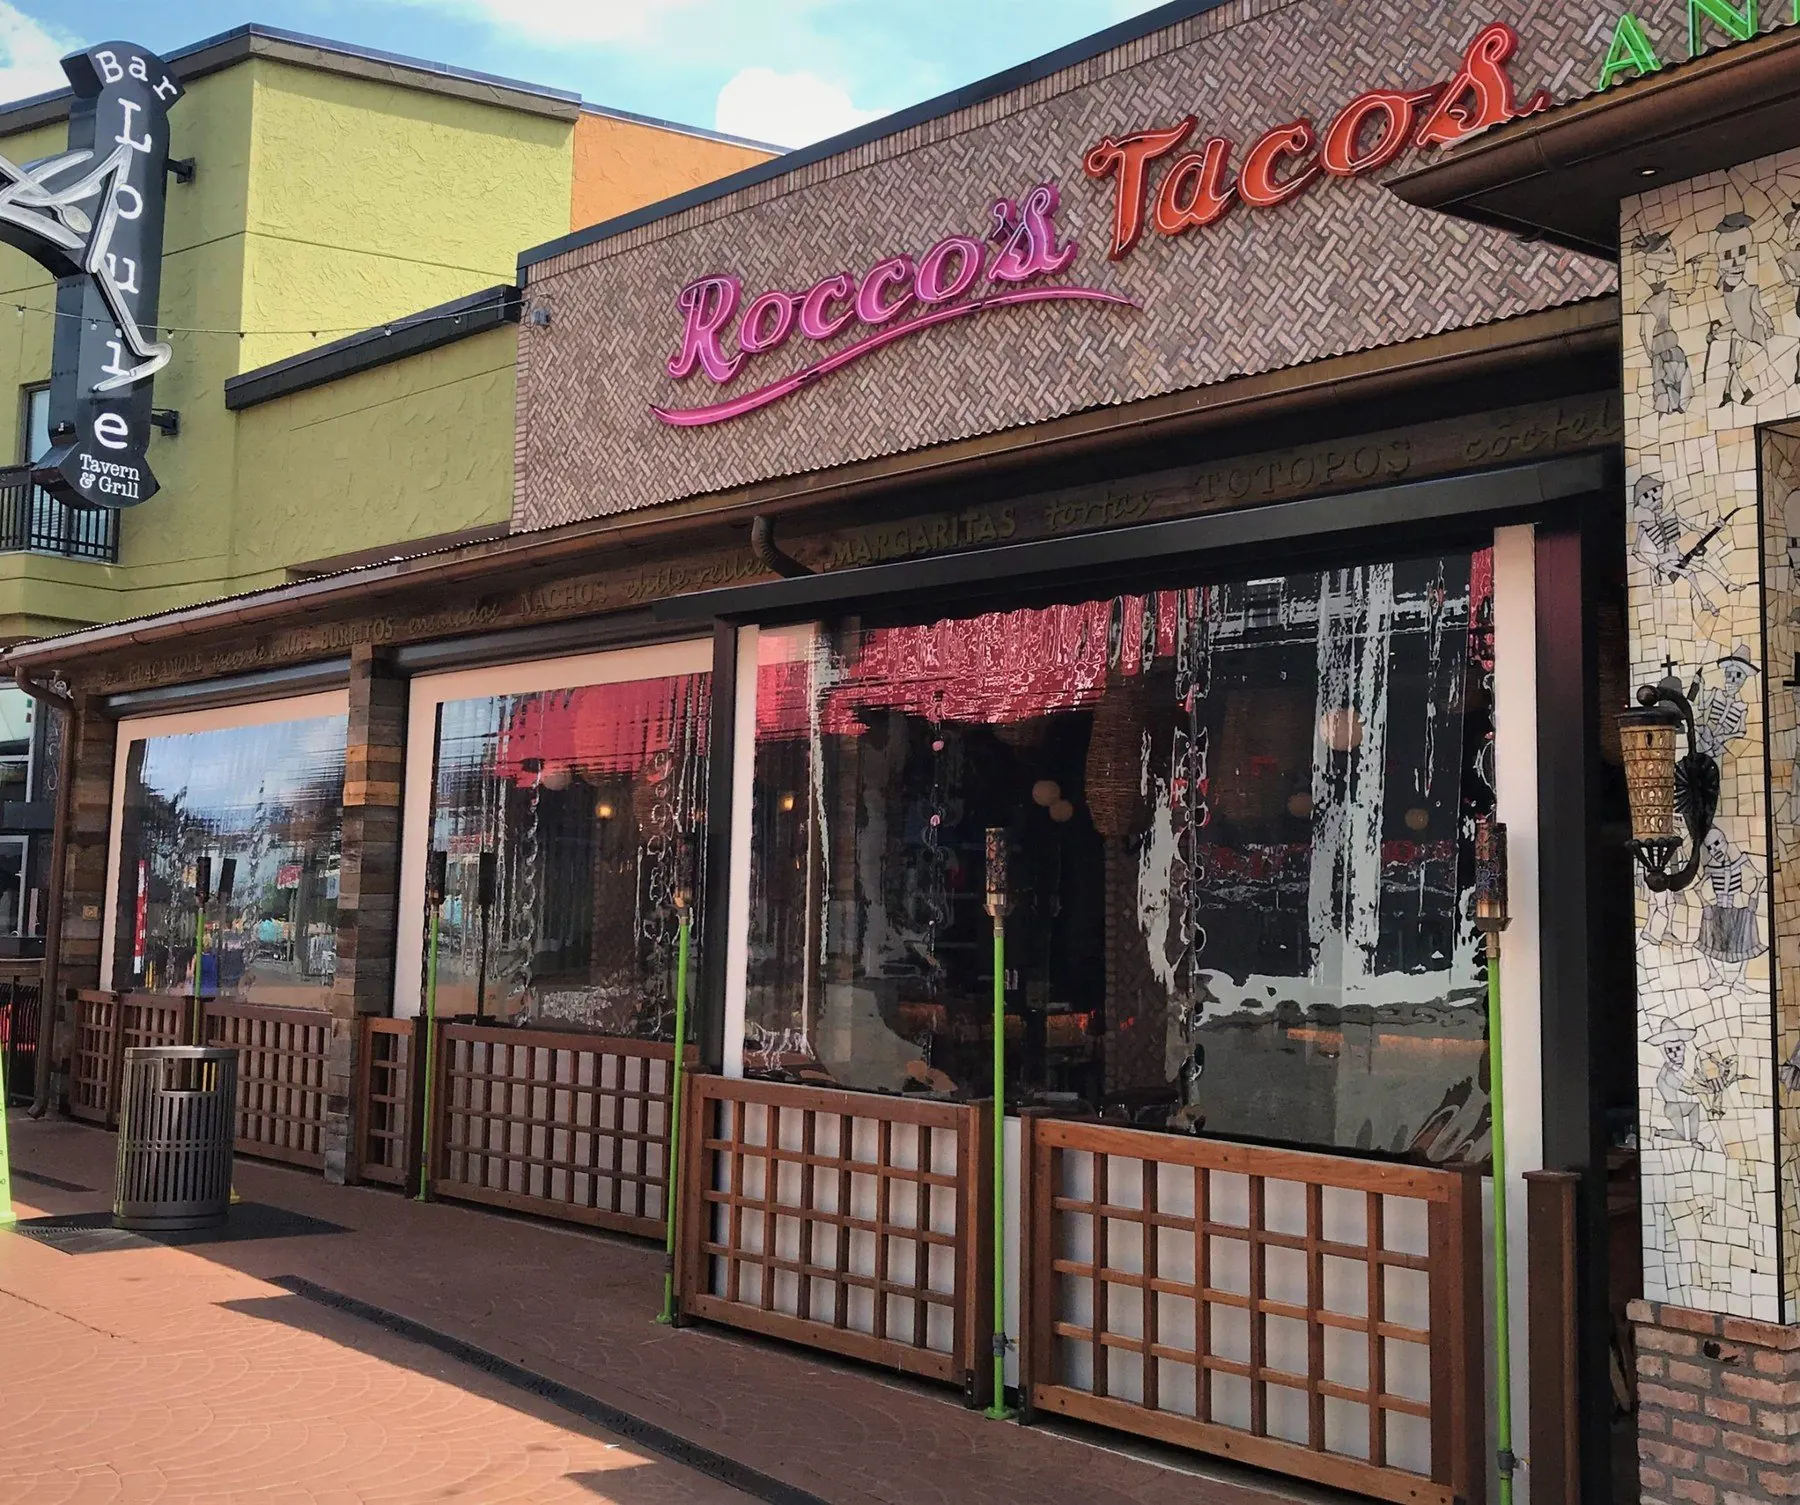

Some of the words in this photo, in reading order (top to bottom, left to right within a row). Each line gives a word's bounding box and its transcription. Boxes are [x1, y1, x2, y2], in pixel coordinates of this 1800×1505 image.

[95, 50, 177, 101] Bar
[667, 183, 1077, 383] Rocco's
[1083, 22, 1552, 262] Tacos
[1598, 0, 1800, 91] AN
[79, 472, 96, 489] &
[98, 476, 139, 499] Grill
[80, 453, 140, 481] Tavern
[319, 616, 394, 650] BURRITOS
[518, 580, 608, 616] NACHOS
[1194, 437, 1411, 503] TOTOPOS
